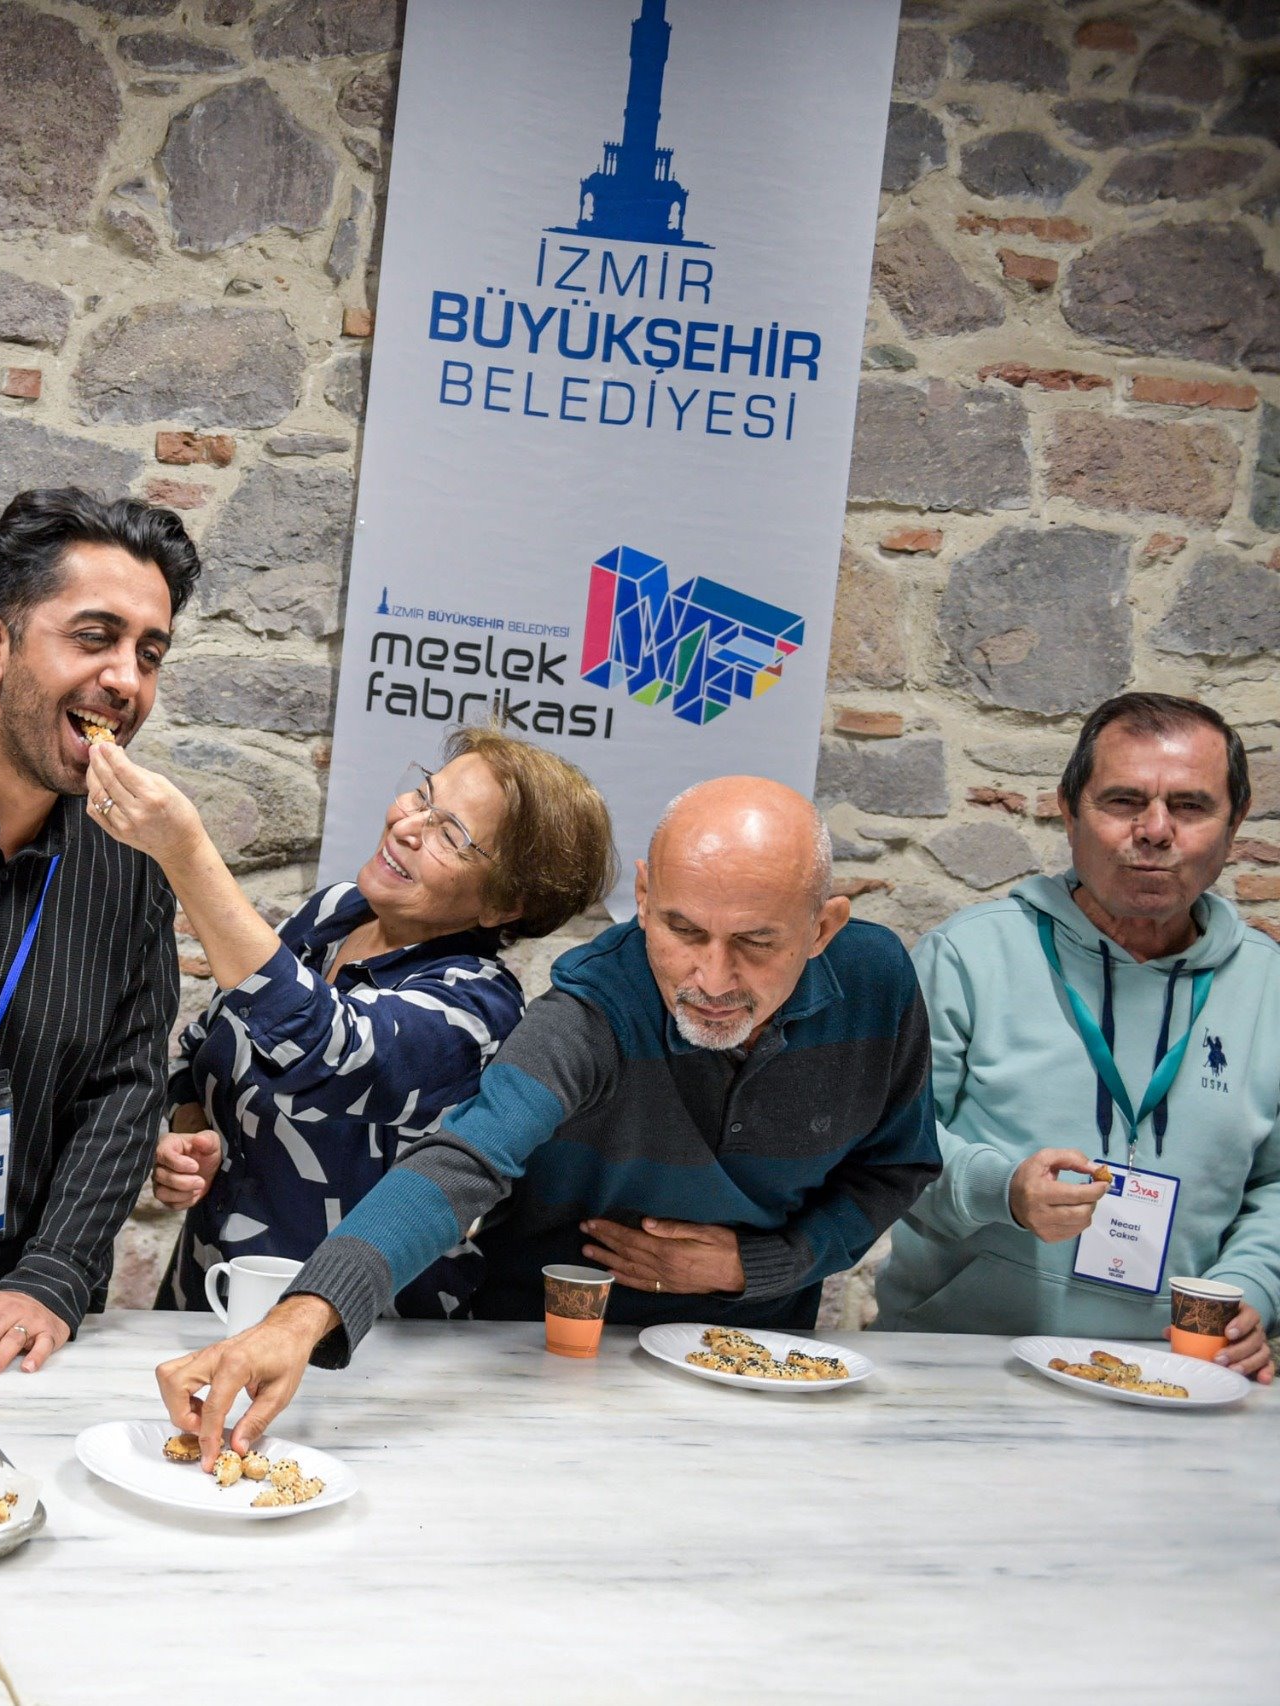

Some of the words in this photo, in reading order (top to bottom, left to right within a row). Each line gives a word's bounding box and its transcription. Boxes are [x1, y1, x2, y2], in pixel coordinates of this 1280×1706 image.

[535, 237, 714, 305] İZMİR
[428, 286, 822, 381] BÜYÜKŞEHİR
[438, 360, 797, 441] BELEDİYESİ
[392, 604, 425, 620] İZMİR
[427, 608, 505, 630] BÜYÜKŞEHİR
[507, 620, 570, 639] BELEDİYESİ
[370, 631, 568, 686] meslek
[366, 671, 614, 740] fabrikası
[1201, 1077, 1229, 1094] USPA
[1109, 1229, 1138, 1241] Çakıcı
[1110, 1218, 1141, 1230] Necati
